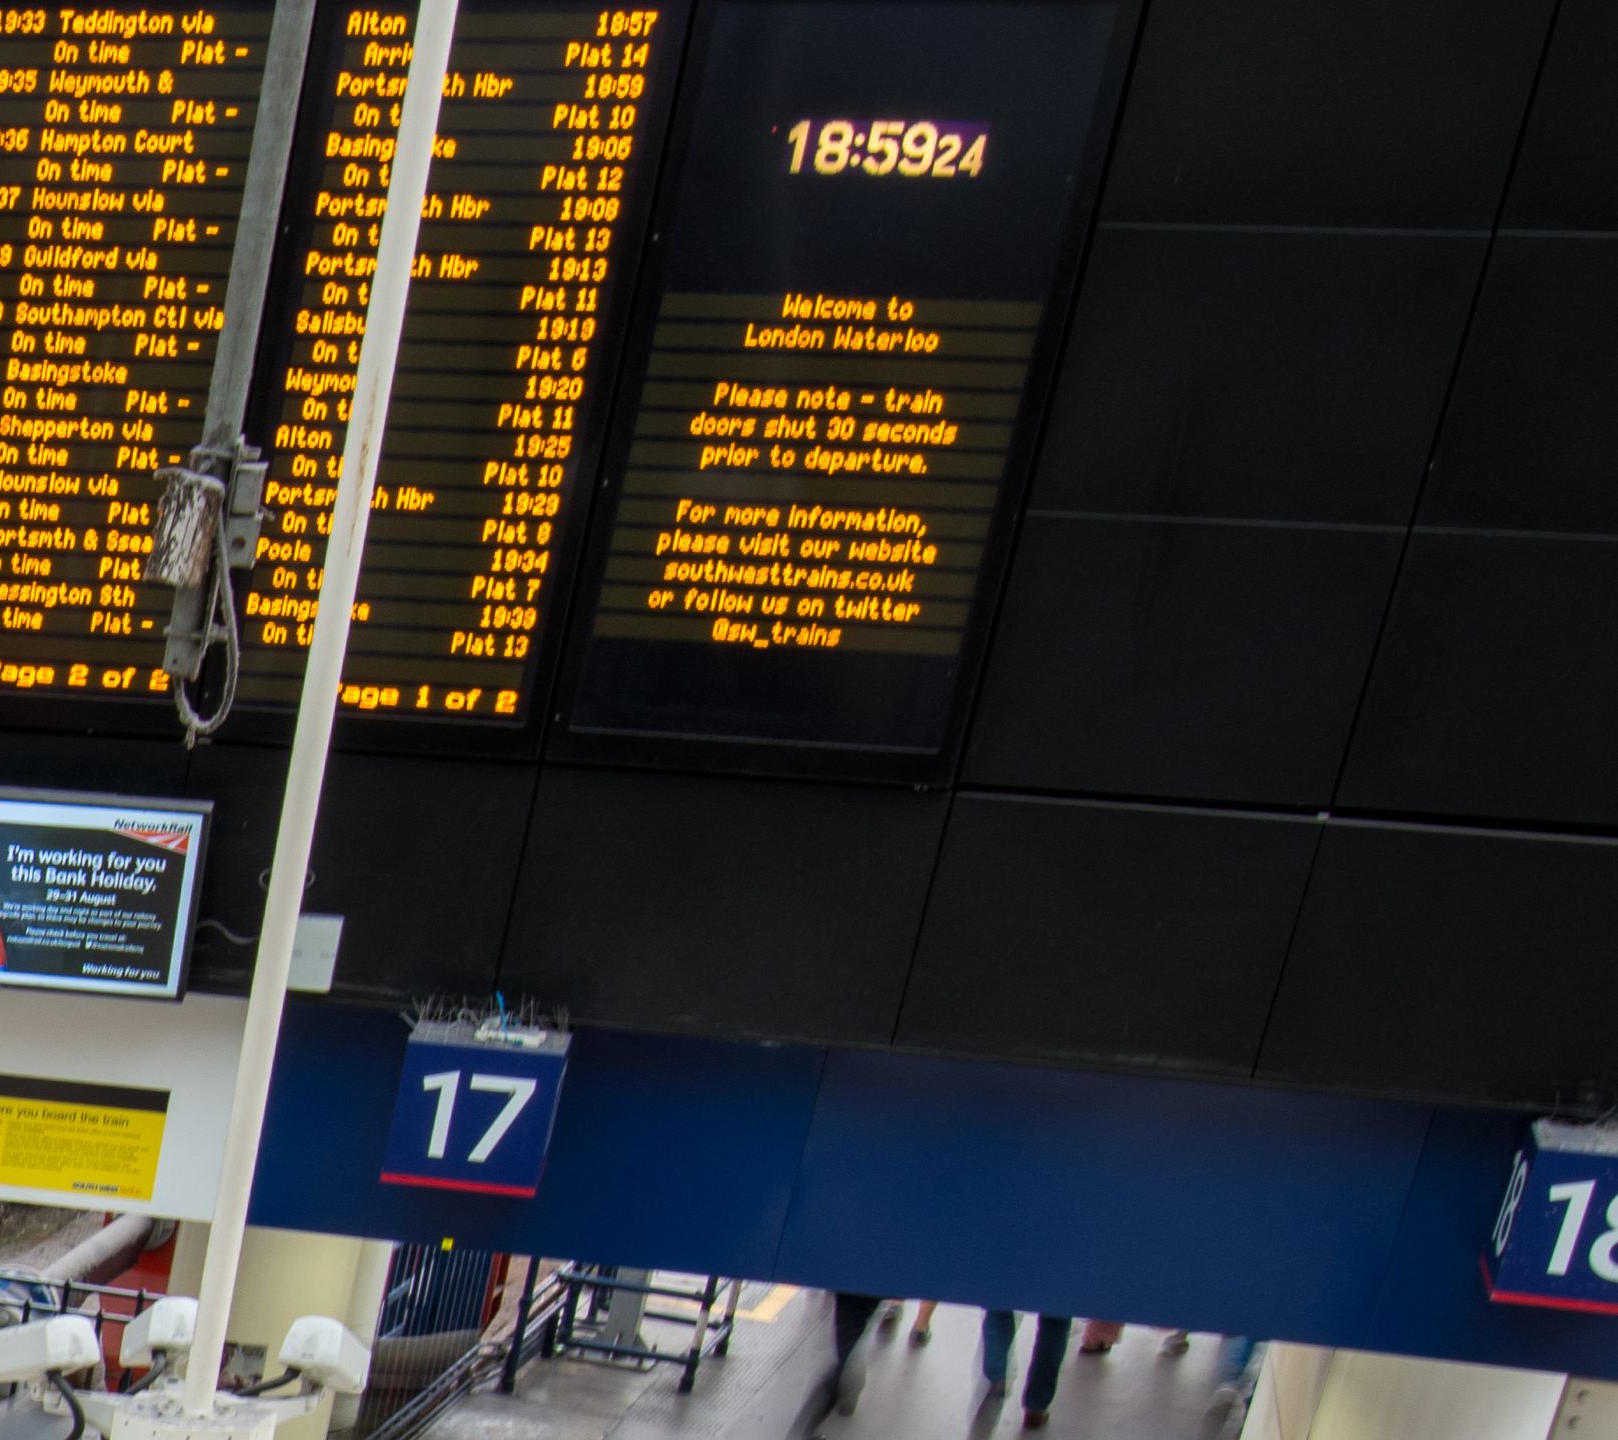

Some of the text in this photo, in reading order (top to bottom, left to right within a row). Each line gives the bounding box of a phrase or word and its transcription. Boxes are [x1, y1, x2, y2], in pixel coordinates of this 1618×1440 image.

[60, 9, 175, 39] Teddington
[182, 10, 216, 34] via
[782, 293, 914, 321] Welcome to
[744, 323, 940, 353] London Waterloo
[713, 382, 944, 414] Please note - train
[690, 411, 958, 445] doors shut 30 seconds
[699, 442, 927, 475] prior to departure.
[676, 499, 927, 539] For more information,
[656, 528, 938, 565] please visit our website
[663, 559, 915, 593] southwesttrains.co.uk
[648, 587, 921, 622] or follow us on twitter
[712, 617, 842, 649] @sw_trains
[7, 845, 166, 873] I'm working for you
[11, 865, 41, 883] this
[45, 867, 86, 886] Bank
[79, 891, 117, 906] August
[82, 962, 123, 977] Working
[124, 966, 140, 979] for
[17, 1107, 39, 1120] you
[42, 1108, 76, 1123] board
[80, 1112, 99, 1125] the
[103, 1115, 129, 1127] train
[423, 1070, 538, 1162] 17
[1492, 1150, 1528, 1258] 18
